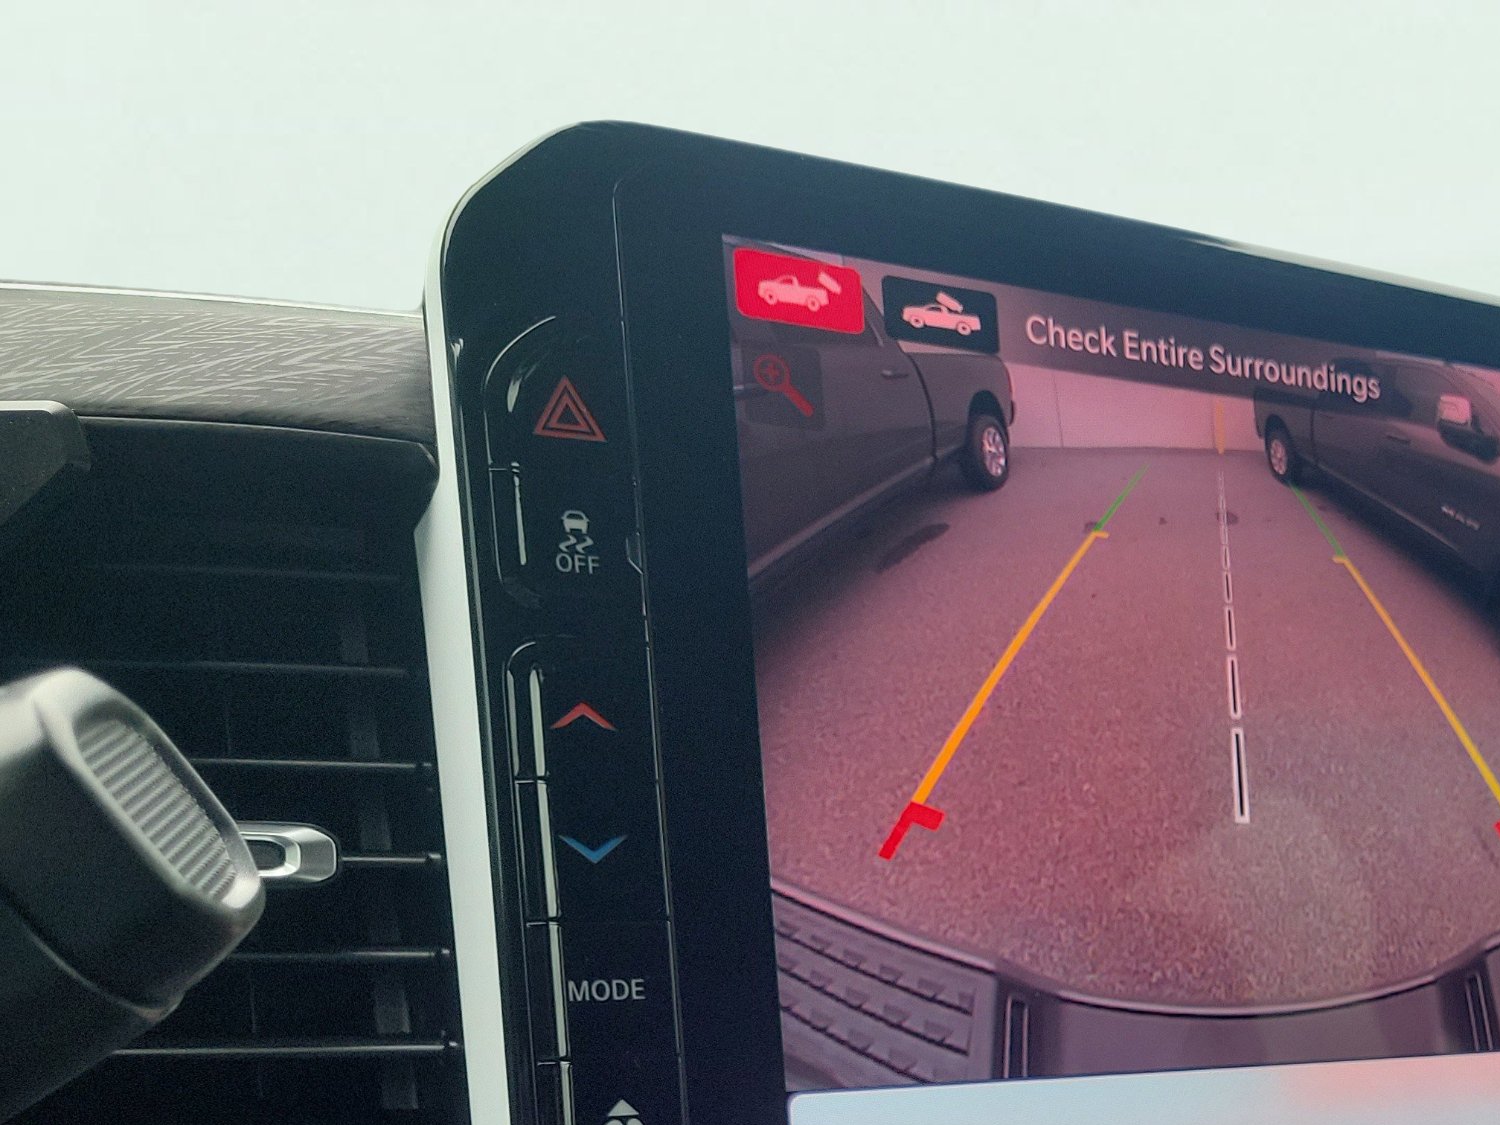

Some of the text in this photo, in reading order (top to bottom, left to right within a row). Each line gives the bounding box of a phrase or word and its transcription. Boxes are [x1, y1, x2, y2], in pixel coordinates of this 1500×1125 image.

[1025, 314, 1382, 403] Check Entire Surroundings
[555, 552, 600, 575] OFF
[567, 979, 646, 1002] MODE
